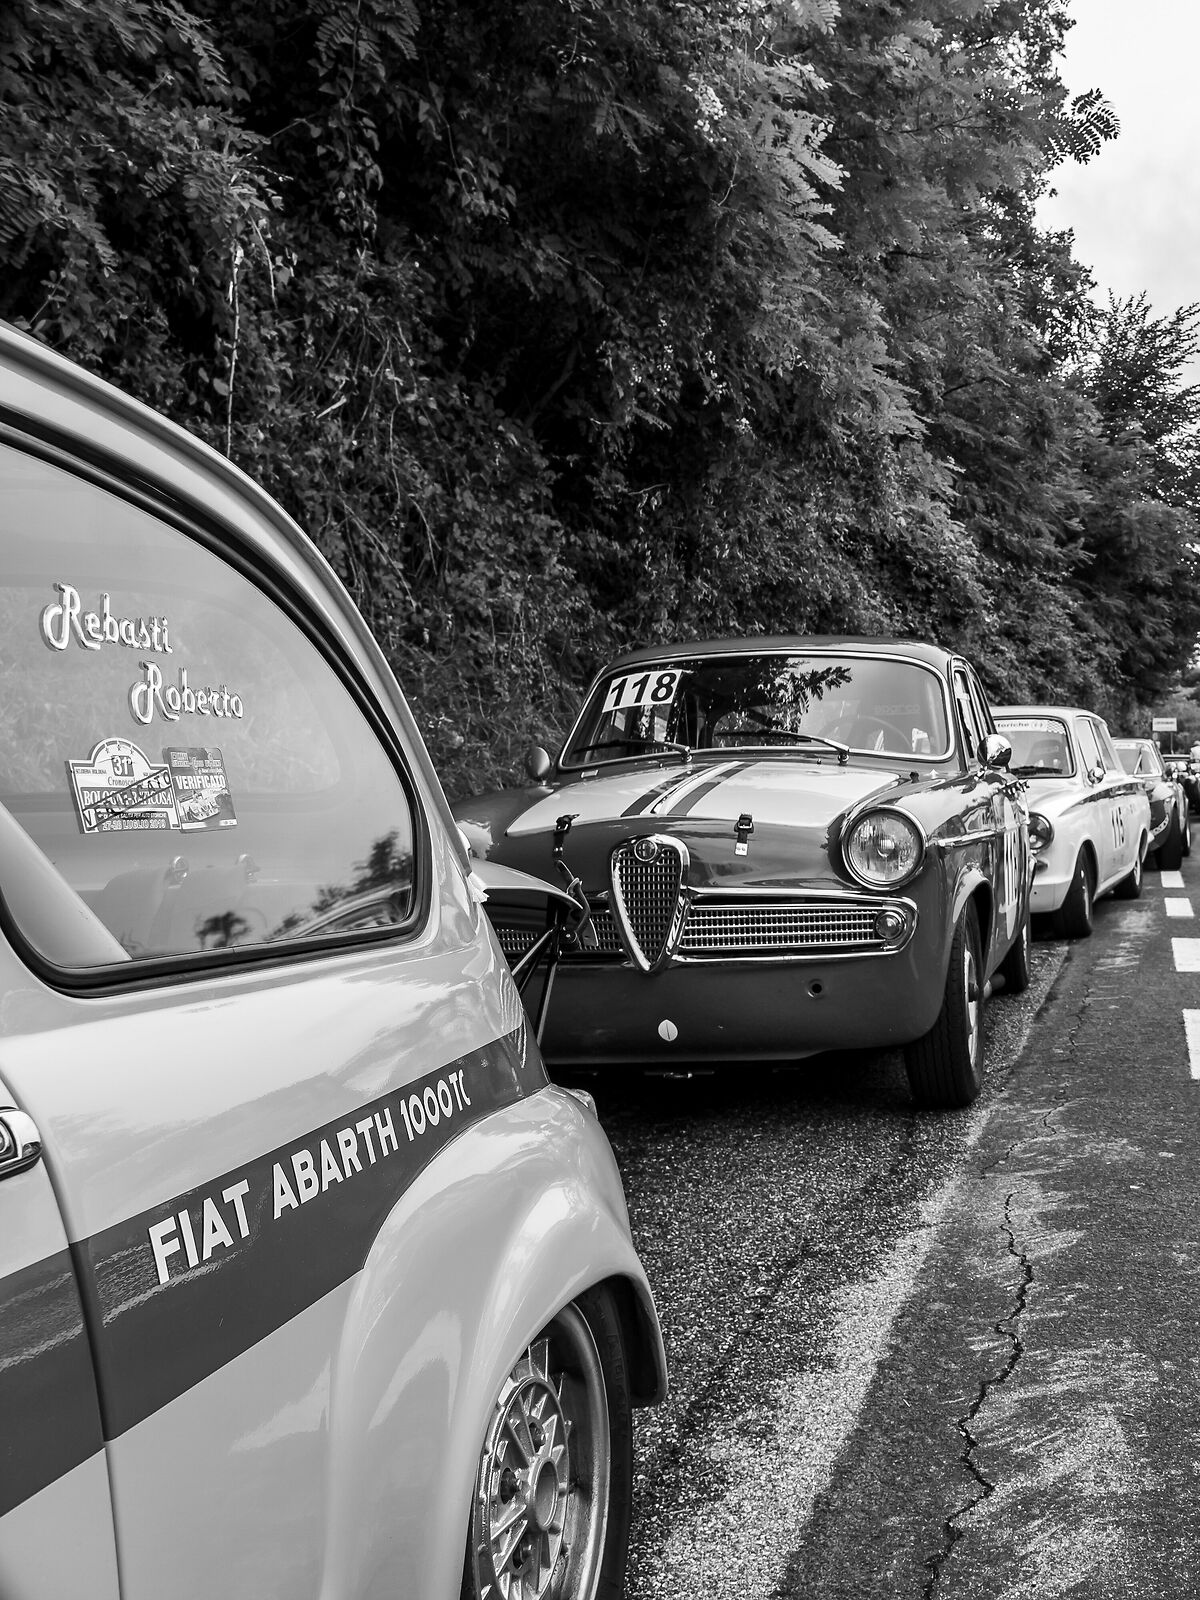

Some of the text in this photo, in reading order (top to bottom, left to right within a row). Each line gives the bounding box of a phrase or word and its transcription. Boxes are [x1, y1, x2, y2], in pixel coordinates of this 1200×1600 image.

[40, 582, 173, 654] Rebasti
[609, 672, 677, 708] 118
[175, 774, 226, 790] VERIFICATO
[148, 1069, 471, 1285] FIAT ABARTH 1000TC
